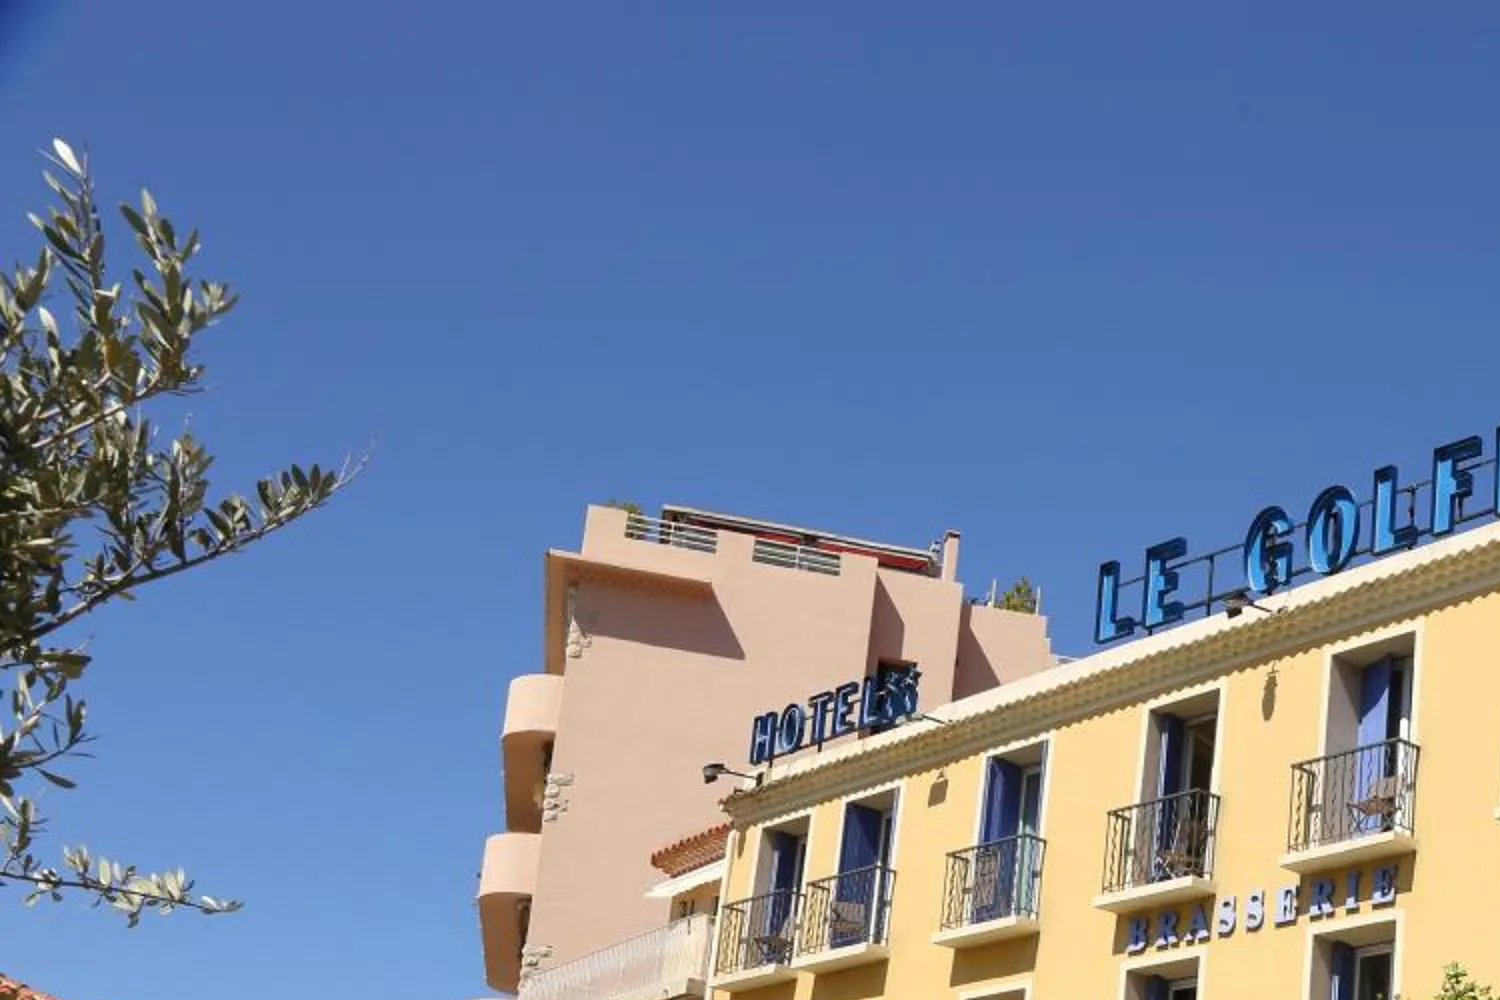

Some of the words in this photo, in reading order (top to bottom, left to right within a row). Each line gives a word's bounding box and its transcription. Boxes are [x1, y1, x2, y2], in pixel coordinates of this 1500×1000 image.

[1094, 537, 1188, 644] LE
[750, 675, 879, 765] HOTEL
[1126, 864, 1398, 955] BRASSERIE
